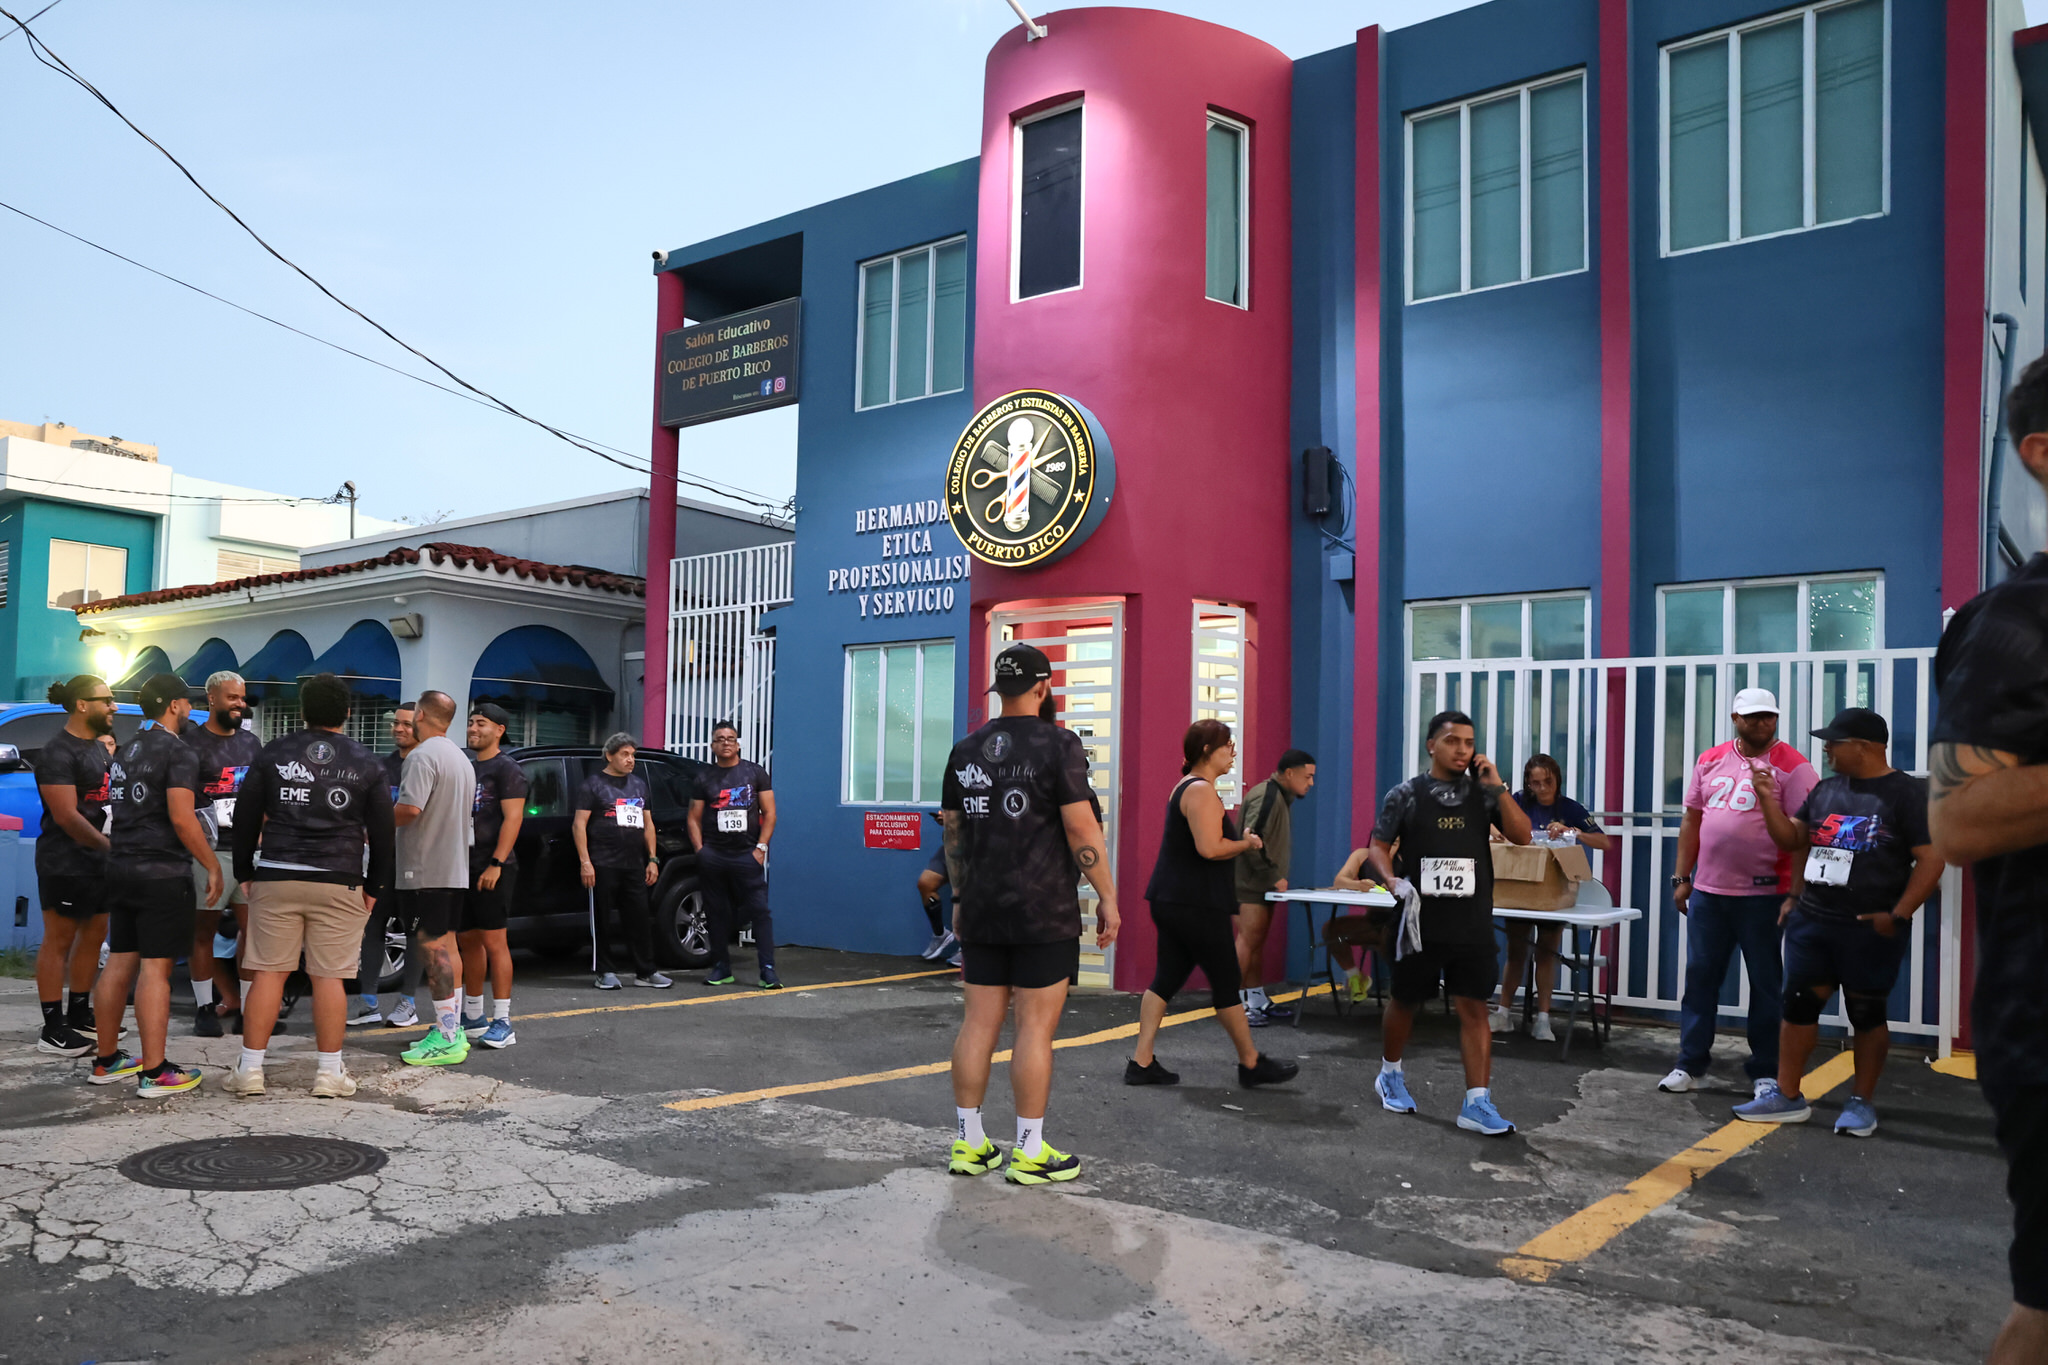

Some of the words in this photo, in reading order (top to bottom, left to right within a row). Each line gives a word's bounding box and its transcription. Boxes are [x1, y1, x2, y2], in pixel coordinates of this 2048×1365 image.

[685, 332, 715, 350] Salón
[717, 319, 771, 342] Educativo
[667, 353, 713, 374] COLEGIO
[715, 349, 730, 363] DE
[732, 335, 789, 359] BARBEROS
[682, 377, 697, 391] DE
[698, 366, 741, 387] PUERTO
[743, 359, 771, 377] RICO
[951, 449, 968, 494] COLEGIO
[963, 435, 976, 451] DE
[972, 401, 1014, 437] BARBEROS
[1013, 399, 1021, 409] Y
[1021, 397, 1065, 419] ESTILISTAS
[1062, 413, 1075, 428] EN
[1045, 461, 1067, 473] 1989
[855, 498, 950, 533] HERMANDA
[882, 529, 933, 557] ETICA
[967, 531, 1025, 559] PUERTO
[1029, 524, 1065, 555] RICO
[828, 554, 971, 591] PROFESIONALIS
[858, 594, 869, 616] Y
[873, 586, 955, 616] SERVICIO
[280, 787, 311, 802] EME
[1708, 776, 1757, 811] 26
[626, 815, 637, 824] 97
[724, 819, 742, 829] 139
[866, 814, 919, 822] ESTACIONAMIENTO
[1817, 813, 1868, 840] 5K
[1433, 875, 1464, 890] 142
[1819, 864, 1826, 878] 1
